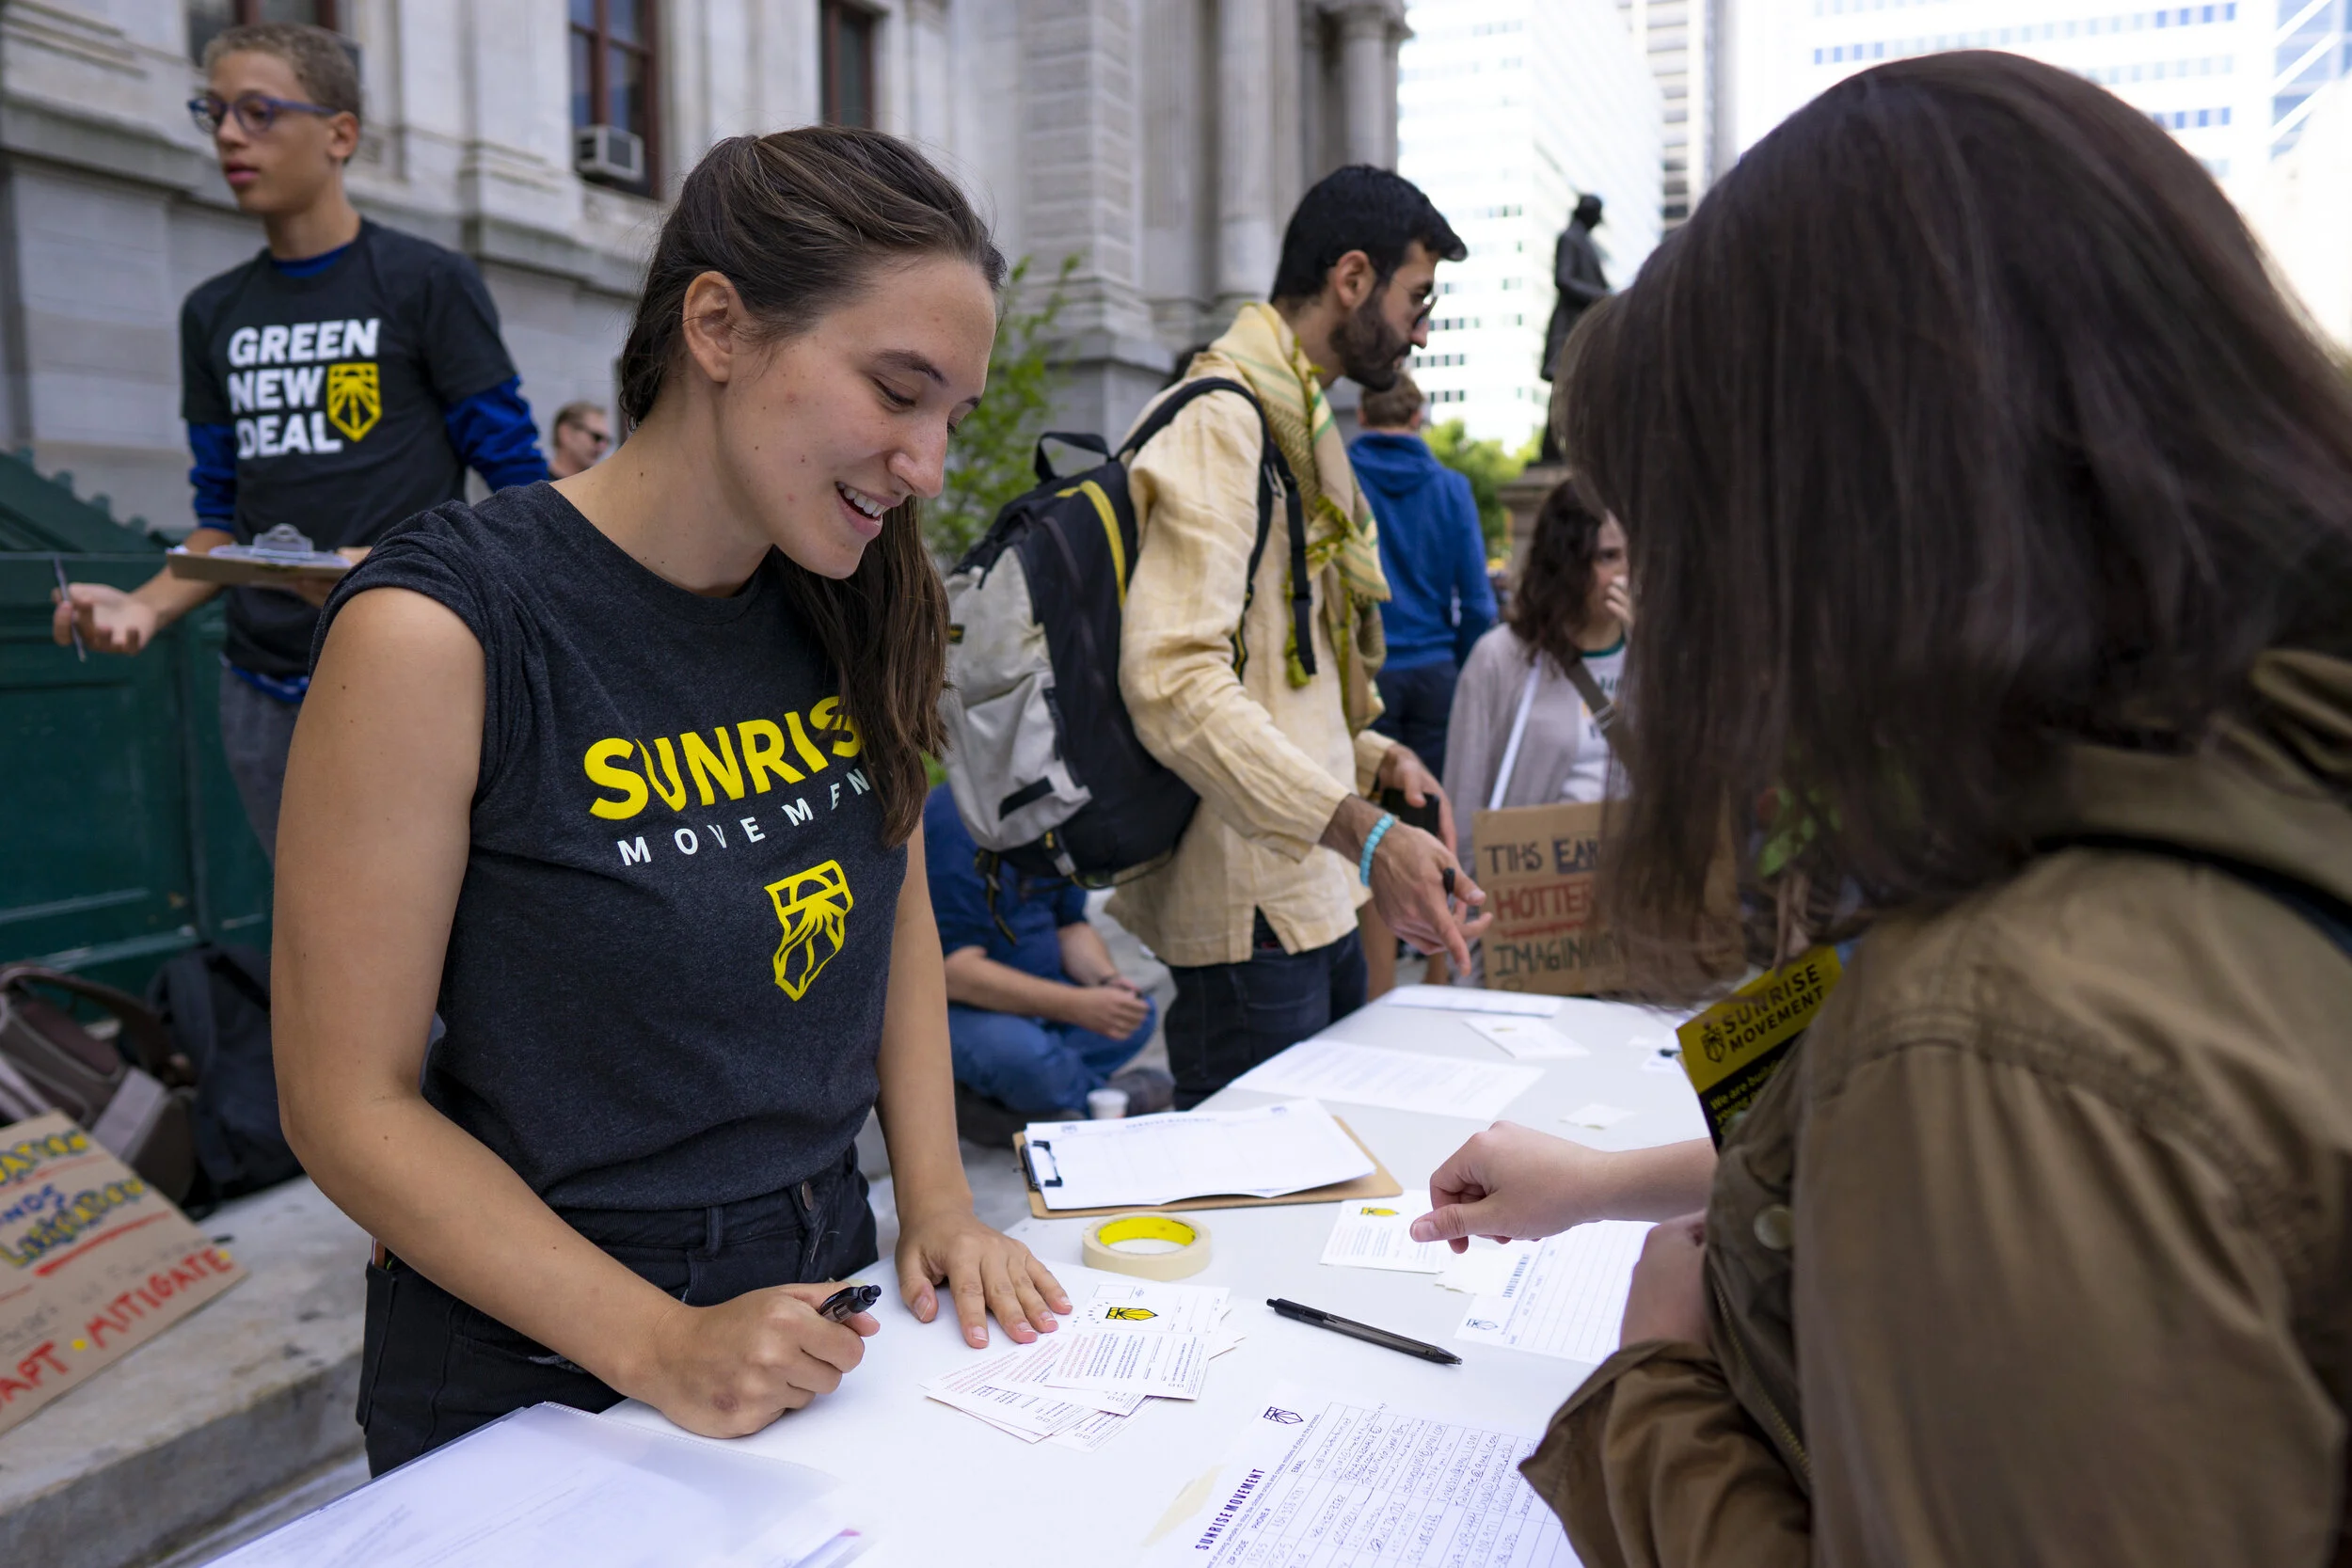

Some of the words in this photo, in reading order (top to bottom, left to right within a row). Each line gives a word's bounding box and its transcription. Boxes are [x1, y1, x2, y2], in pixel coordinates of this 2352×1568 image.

[228, 318, 380, 367] GREEN
[228, 365, 325, 414] NEW
[236, 413, 342, 460] DEAL
[584, 696, 863, 820] SUNRIS
[616, 768, 871, 866] MOVEMEN
[1722, 963, 1821, 1034] SUNRISE
[1729, 985, 1824, 1053] MOVEMENT
[1195, 1513, 1233, 1550] SUNRISE
[1224, 1468, 1265, 1512] MOVEMENT
[1251, 1512, 1269, 1528] PHONE
[1291, 1459, 1306, 1473] EMAIL
